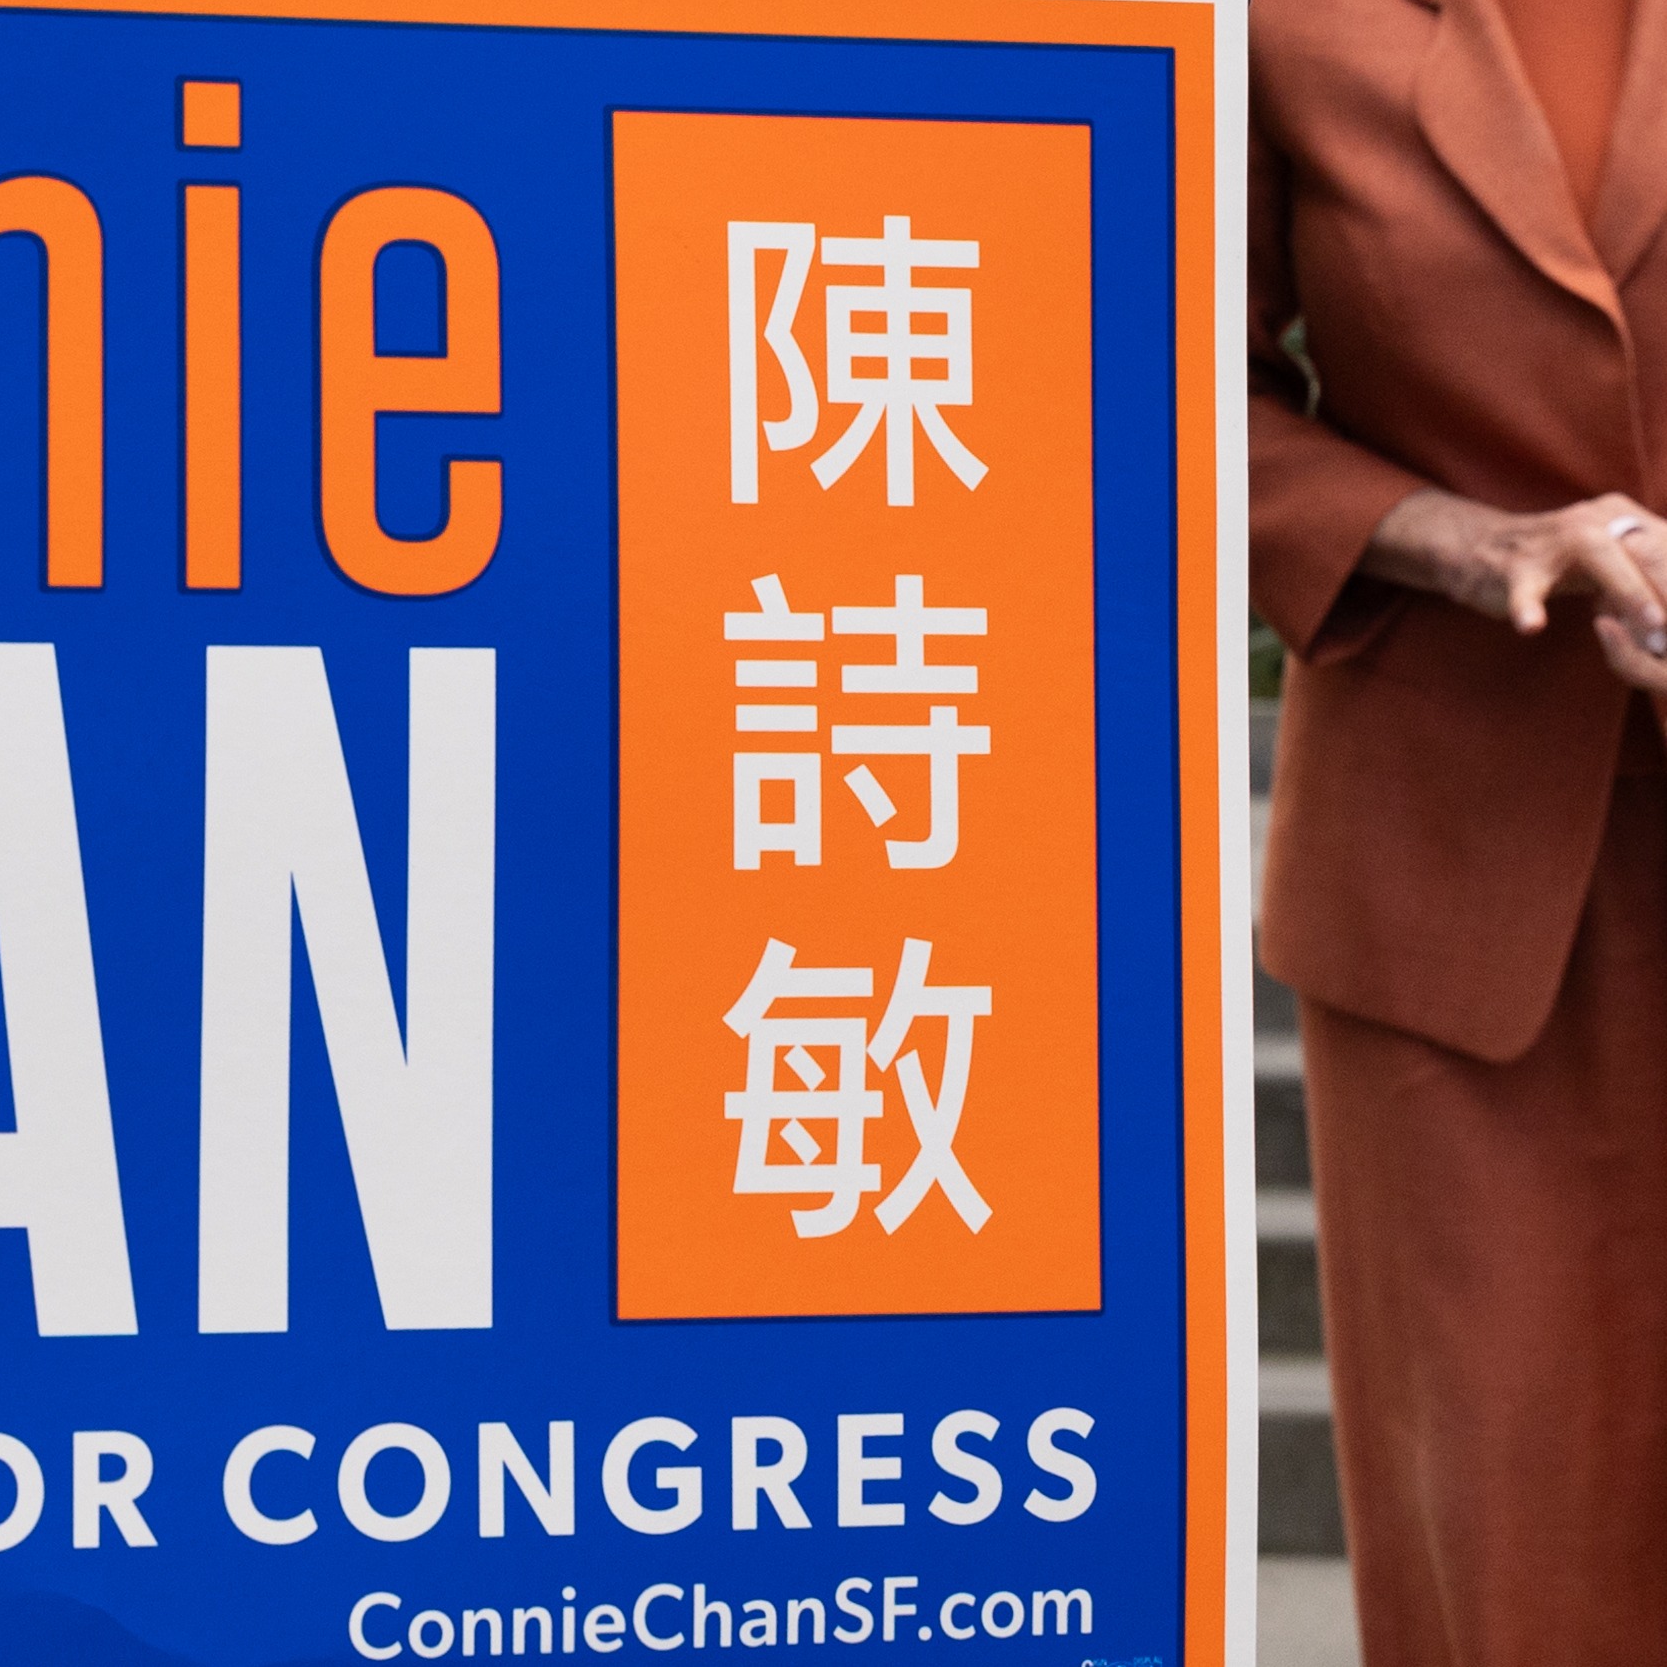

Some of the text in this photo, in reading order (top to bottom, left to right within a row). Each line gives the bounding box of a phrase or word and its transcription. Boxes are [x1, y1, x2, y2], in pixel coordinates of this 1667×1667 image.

[722, 215, 994, 1239] 陳詩敏
[222, 1406, 1098, 1546] CONGRESS
[348, 1575, 1093, 1661] ConnieChanSF.com
